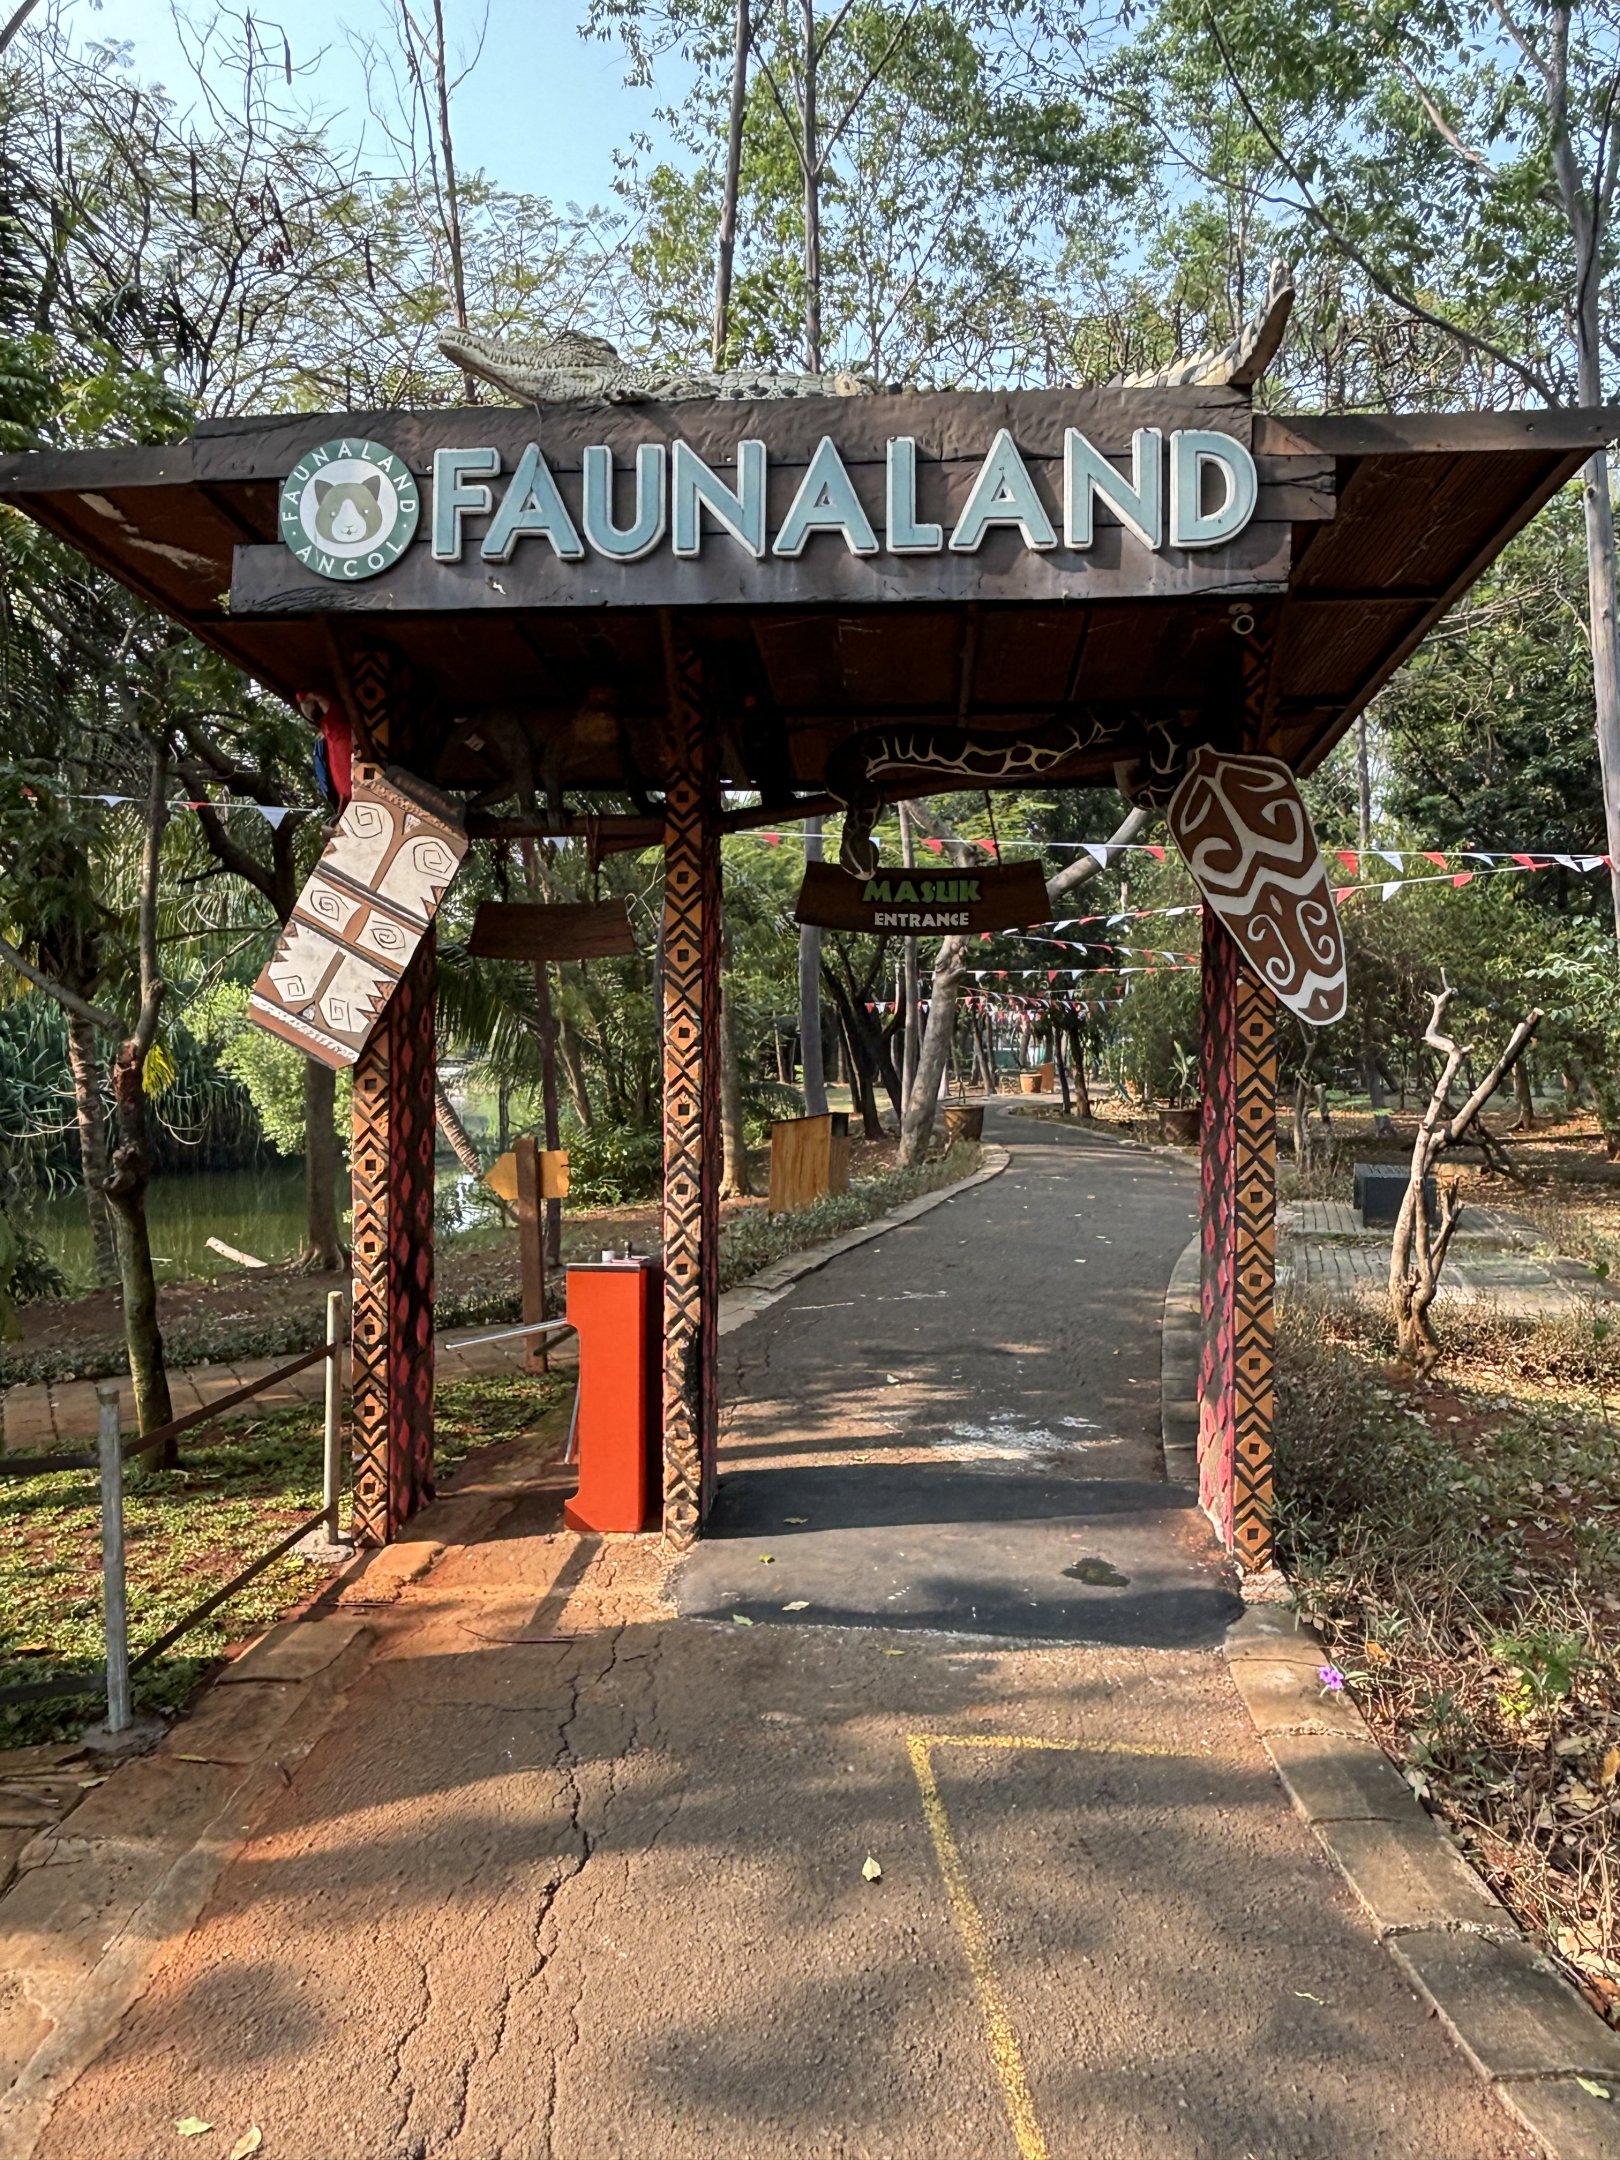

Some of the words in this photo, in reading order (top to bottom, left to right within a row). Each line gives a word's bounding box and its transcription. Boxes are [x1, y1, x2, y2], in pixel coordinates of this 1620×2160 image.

[282, 440, 416, 522] FAUNALAND
[431, 427, 1258, 562] FAUNALAND
[295, 541, 403, 577] ANCOL
[862, 879, 982, 903] MASUK
[874, 912, 969, 927] ENTRANCE
